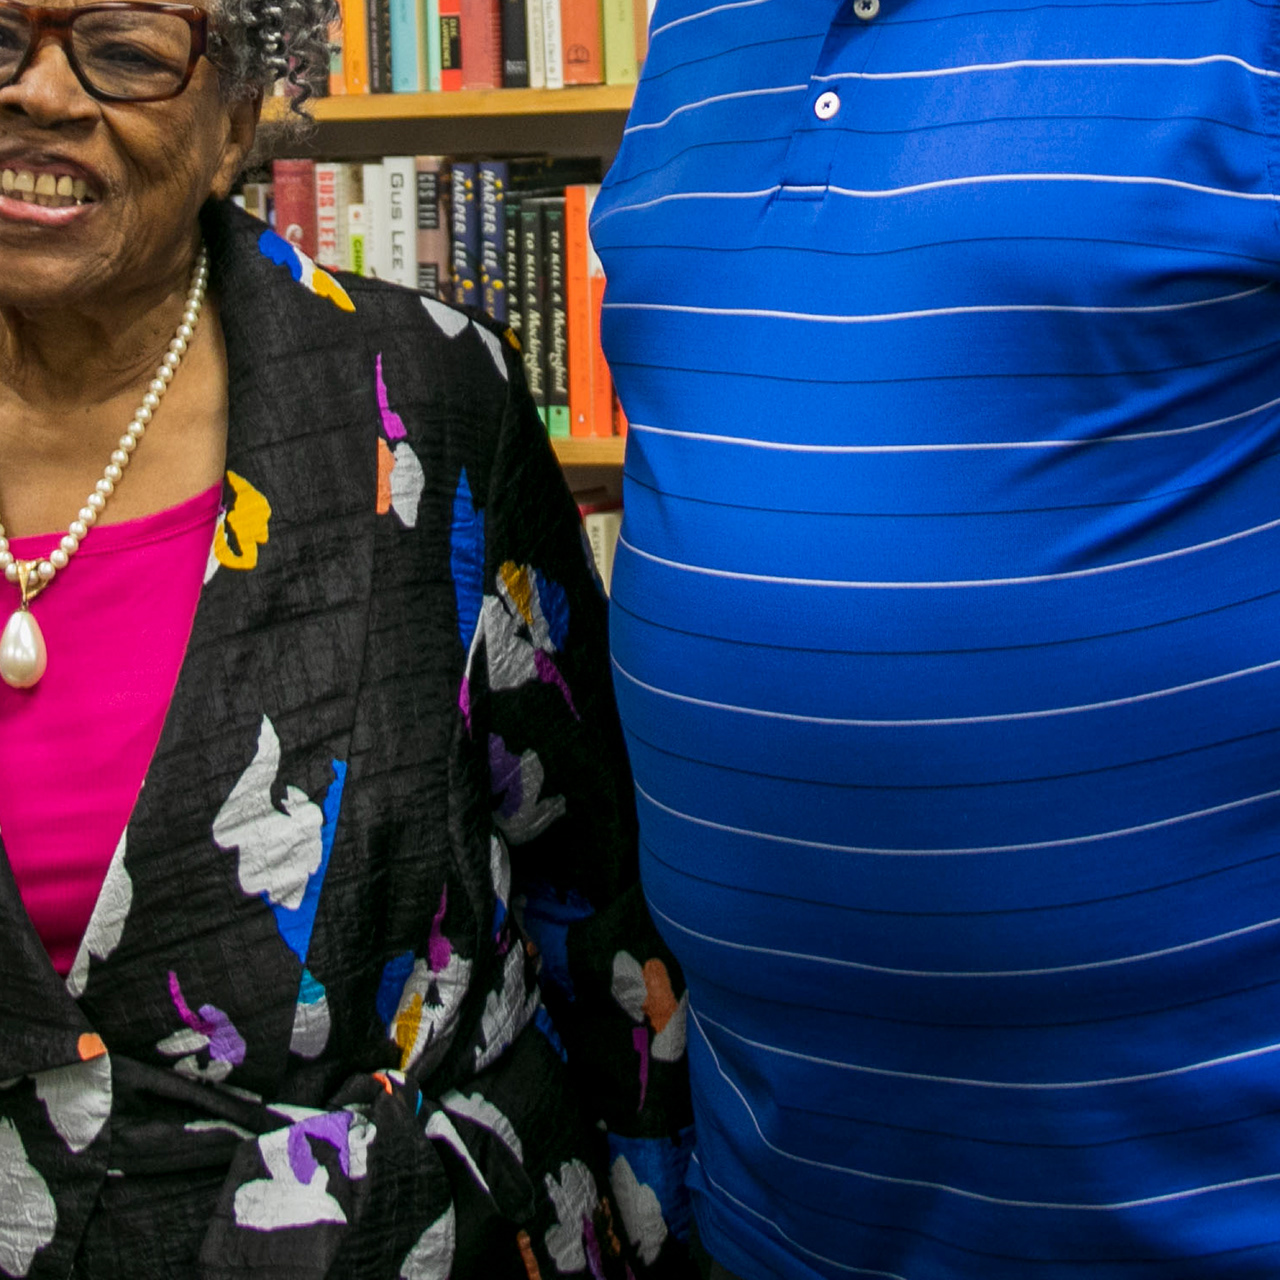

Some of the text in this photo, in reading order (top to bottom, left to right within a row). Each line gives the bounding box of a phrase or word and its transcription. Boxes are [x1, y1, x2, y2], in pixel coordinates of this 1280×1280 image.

[390, 172, 404, 270] GUS LEE
[453, 168, 466, 268] HARPER LEE
